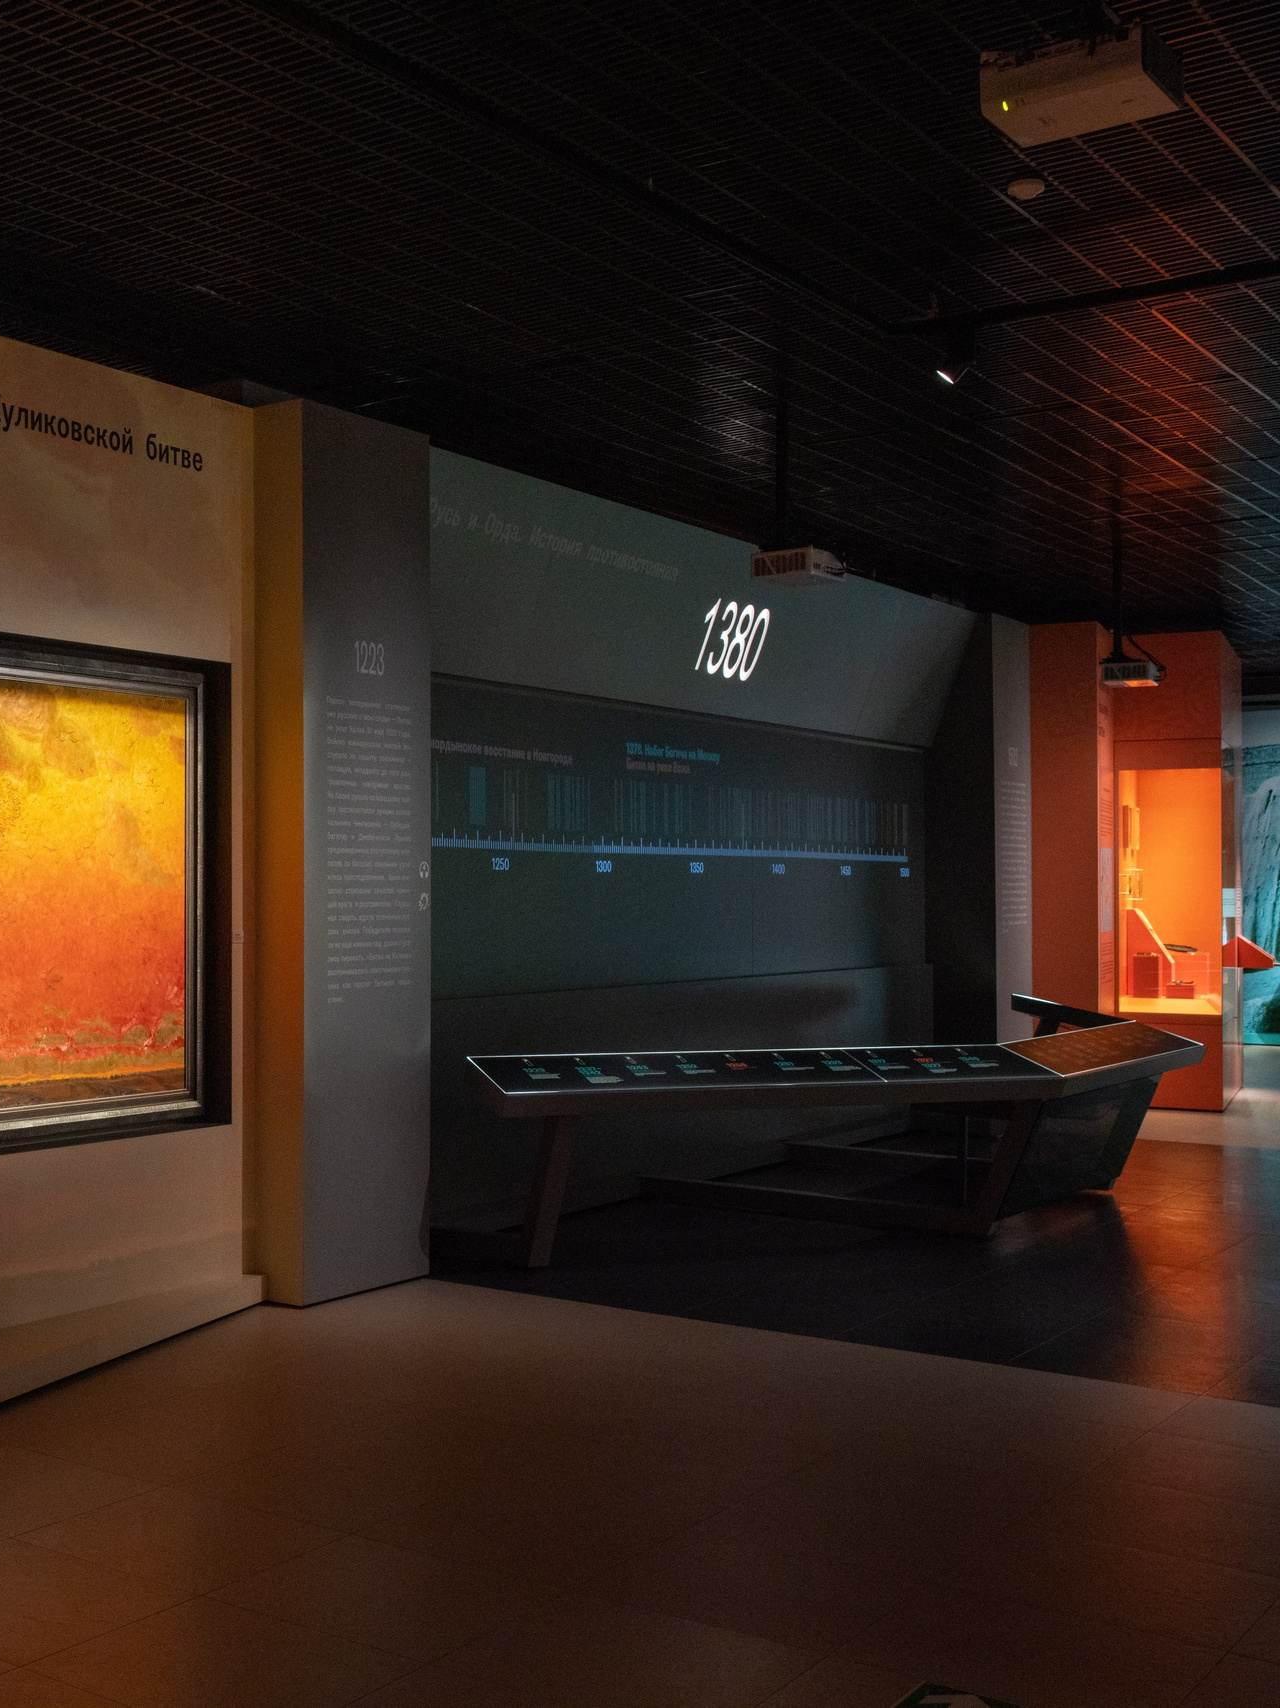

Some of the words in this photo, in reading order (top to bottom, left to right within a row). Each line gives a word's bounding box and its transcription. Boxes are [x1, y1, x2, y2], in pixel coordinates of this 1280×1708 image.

[146, 434, 204, 472] битве
[528, 525, 582, 556] История
[586, 544, 679, 583] противостояния
[354, 640, 385, 676] 1223
[694, 597, 771, 682] 1380
[491, 858, 510, 872] 1250
[596, 860, 612, 874] 1300
[689, 862, 704, 874] 1350
[772, 863, 786, 876] 1400
[840, 864, 852, 876] 1450
